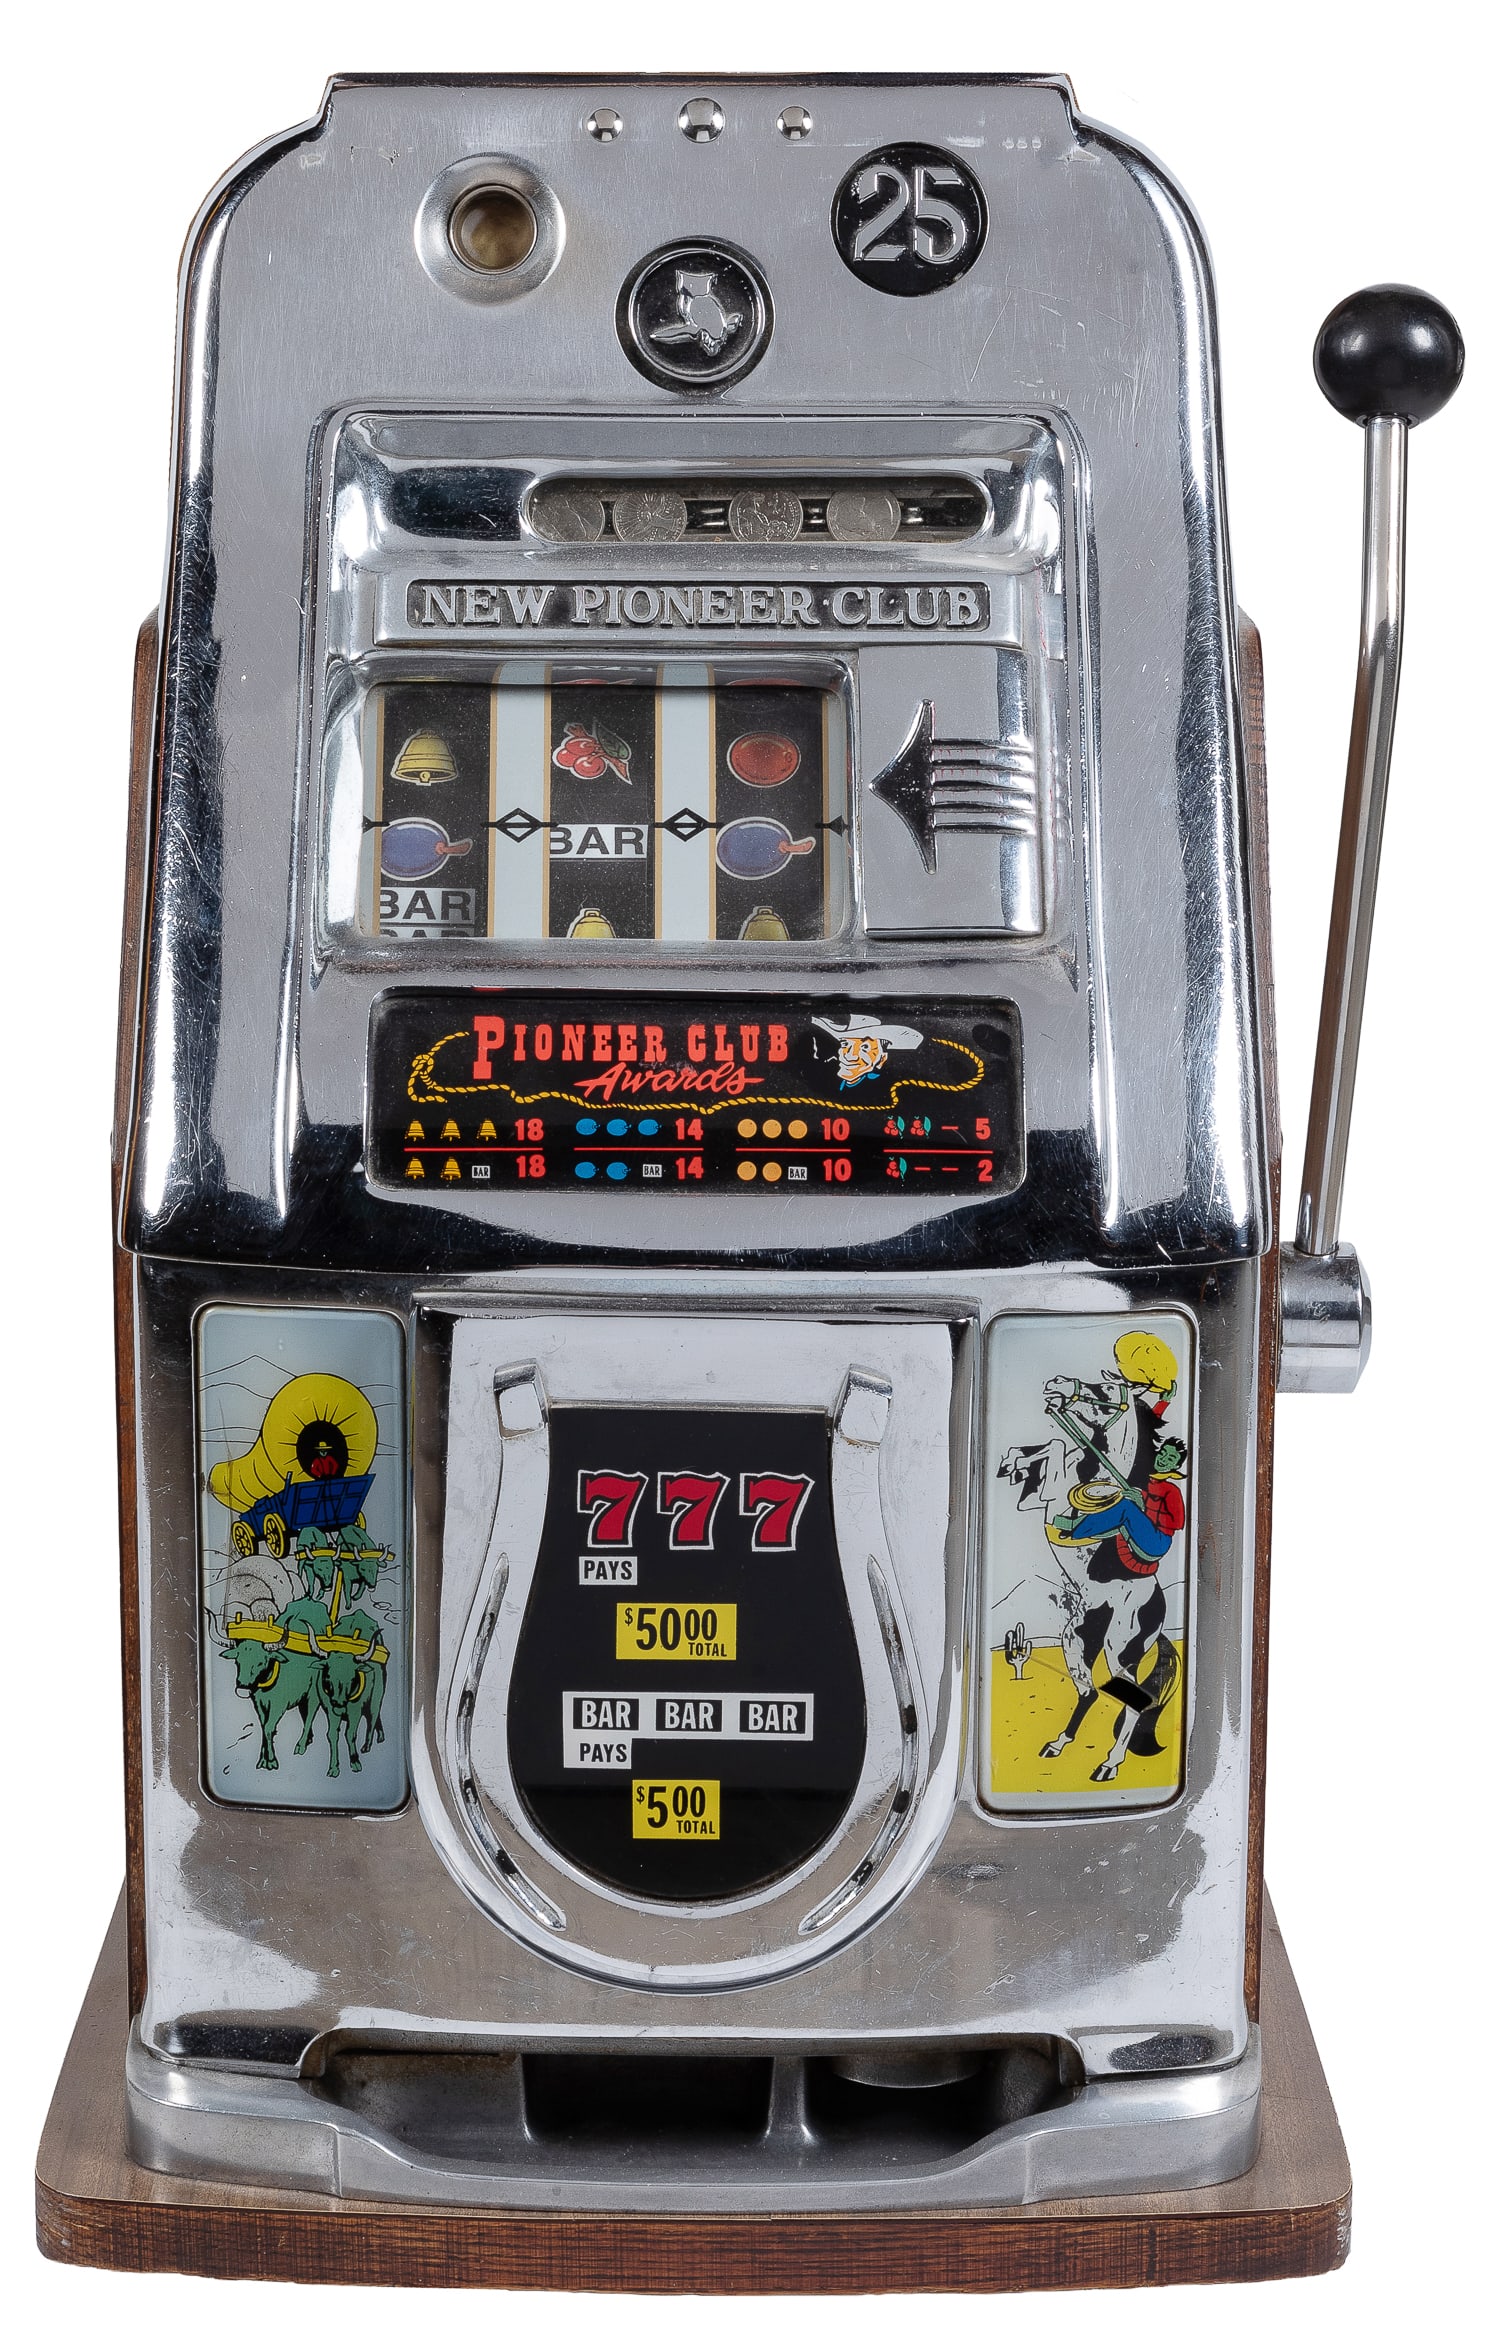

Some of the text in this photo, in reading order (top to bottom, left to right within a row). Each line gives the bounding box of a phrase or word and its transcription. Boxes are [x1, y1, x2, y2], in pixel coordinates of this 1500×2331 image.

[852, 163, 967, 265] 25
[422, 585, 981, 626] NEW PIONEER CLUB
[549, 826, 645, 855] BAR
[380, 888, 472, 921] BAR
[473, 1015, 789, 1080] PIONEER CLUB
[573, 1062, 765, 1101] Awards
[514, 1117, 545, 1141] 18
[675, 1117, 704, 1141] 14
[821, 1117, 850, 1141] 10
[975, 1117, 991, 1140] 5
[473, 1154, 546, 1178] BAR 18
[643, 1156, 704, 1180] BAR 14
[789, 1158, 852, 1182] BAR 10
[977, 1159, 993, 1183] 2
[583, 1560, 633, 1581] PAYS
[687, 1642, 727, 1658] TOTAL
[581, 1700, 799, 1732] BAR BAR BAR
[579, 1743, 628, 1763] PAYS
[676, 1819, 716, 1835] TOTAL
